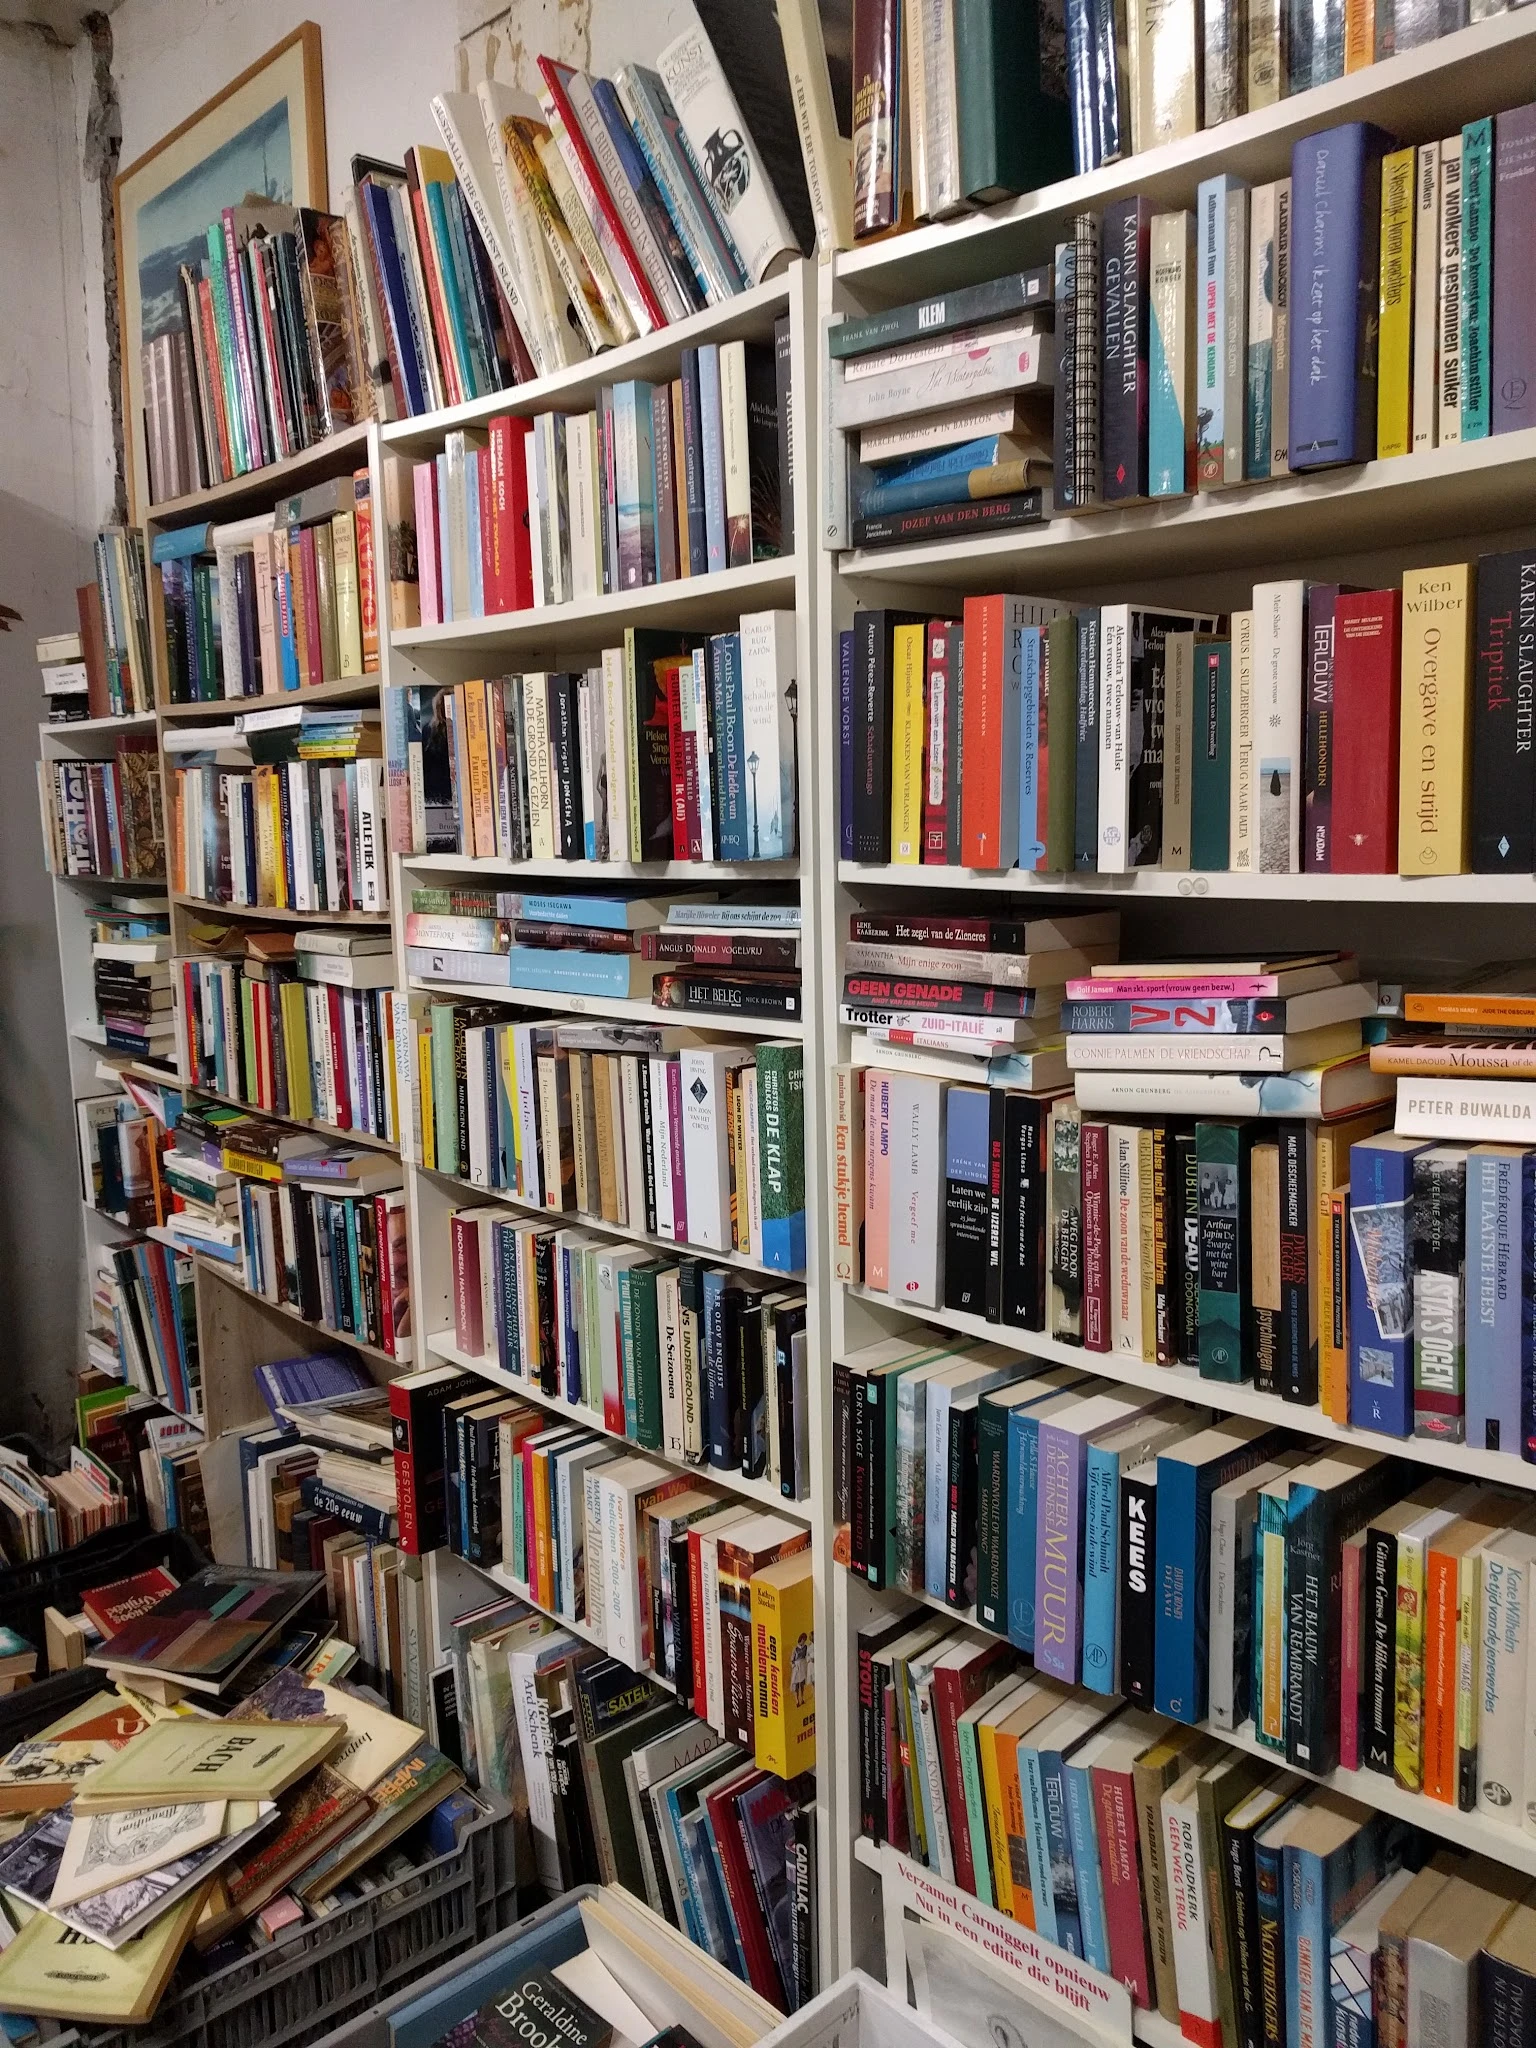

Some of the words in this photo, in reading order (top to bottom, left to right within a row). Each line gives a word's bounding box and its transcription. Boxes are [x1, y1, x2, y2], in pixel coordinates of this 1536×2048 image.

[1442, 157, 1460, 185] jan
[581, 99, 600, 131] HET
[595, 132, 642, 231] BIJBELWOORD
[637, 233, 650, 250] IN
[645, 251, 671, 298] BEELD
[462, 173, 477, 199] THE
[473, 199, 501, 259] GREATEST
[498, 259, 519, 306] ISLAND
[1123, 213, 1139, 271] KARIN
[1445, 188, 1463, 259] wolkers
[918, 302, 946, 329] KLEM
[1104, 257, 1120, 361] GEVALLEN
[1443, 263, 1460, 354] gesponnen
[1122, 277, 1138, 395] SLAUGHTER
[1443, 358, 1461, 408] suiker
[496, 429, 505, 477] HERMAN
[901, 516, 929, 532] JOZEF
[930, 511, 955, 527] VAN
[957, 508, 980, 522] DEN
[982, 503, 1011, 518] BERG
[1406, 598, 1463, 614] Wilber
[1418, 579, 1452, 595] Ken
[1519, 563, 1536, 630] KARIN
[867, 622, 876, 655] Arturo
[1314, 616, 1336, 704] TERLOUW
[1481, 609, 1512, 711] Triptiek
[724, 643, 734, 682] Louis
[842, 641, 850, 703] VALLENDE
[1417, 627, 1442, 737] Overgave
[725, 683, 735, 714] Paul
[867, 656, 876, 722] Pérez-Reverte
[1025, 637, 1036, 741] Strafschopgebieden
[1516, 634, 1535, 754] SLAUGHTER
[726, 715, 737, 753] Boon
[842, 704, 850, 746] VORST
[1317, 709, 1329, 787] HELLEHONDEN
[866, 724, 875, 796] Schaduwtango
[1025, 753, 1034, 796] Reserves
[1421, 744, 1436, 772] en
[1419, 779, 1439, 834] strijd
[362, 811, 375, 870] ATLETIEK
[659, 943, 684, 954] ANGUS
[685, 943, 717, 954] DONALD
[720, 944, 763, 956] VOGELVRIJ
[895, 924, 911, 938] Het
[911, 928, 930, 941] zegel
[930, 930, 943, 939] van
[944, 928, 954, 939] de
[955, 928, 987, 943] Zieneres
[689, 986, 709, 1001] HET
[712, 987, 742, 1003] BELEG
[745, 995, 763, 1004] NICK
[764, 997, 784, 1006] BROWN
[848, 979, 891, 996] GEEN
[893, 981, 963, 1001] GENADE
[1072, 1005, 1115, 1017] ROBERT
[845, 1007, 894, 1025] Trotter
[921, 1016, 985, 1035] ZUID-ITALIË
[1071, 1017, 1115, 1029] HARRIS
[1073, 1048, 1113, 1059] CONNIE
[1115, 1048, 1156, 1059] PALMEN
[1160, 1048, 1174, 1059] DE
[1177, 1048, 1251, 1061] VRIENDSCHAP
[1416, 1058, 1446, 1066] DAOUD
[1448, 1053, 1509, 1068] Moussa
[1523, 1059, 1533, 1067] de
[764, 1069, 773, 1112] TSIOLKAS
[770, 1070, 779, 1113] CHRISTOS
[880, 1081, 889, 1122] HUBERT
[1408, 1099, 1454, 1115] PETER
[1459, 1102, 1532, 1119] BUWALDA
[767, 1113, 780, 1141] DE
[836, 1123, 849, 1150] Een
[879, 1122, 889, 1156] LAMPO
[1287, 1135, 1297, 1160] MARC
[767, 1142, 782, 1194] KLAP
[835, 1152, 852, 1201] stukje
[951, 1184, 972, 1197] Laten
[973, 1188, 986, 1198] we
[1481, 1160, 1496, 1196] HET
[947, 1199, 972, 1212] eerlijk
[973, 1203, 988, 1215] zijn
[1287, 1161, 1298, 1227] DESCHEEMAECKER
[1432, 1171, 1441, 1218] EVELINE
[1498, 1161, 1511, 1241] FRÉDÉRIQUE
[837, 1202, 851, 1247] hemel
[1431, 1220, 1441, 1253] STOEL
[1481, 1197, 1496, 1271] LAATSTE
[457, 1224, 465, 1279] INDONESIA
[1280, 1232, 1294, 1282] LIGGER
[1293, 1233, 1306, 1285] DWARS
[1497, 1242, 1510, 1301] HÉBRARD
[458, 1281, 467, 1331] HANDBOOK
[1420, 1268, 1456, 1335] ASTA'S
[1480, 1275, 1496, 1327] FEEST
[1420, 1336, 1455, 1390] OGEN
[855, 1383, 864, 1426] LORNA
[1046, 1444, 1057, 1460] DE
[401, 1460, 413, 1530] GESTOLEN
[856, 1465, 865, 1504] KWAAD
[1045, 1460, 1057, 1531] CHINESE
[1056, 1447, 1070, 1528] ACHTER
[313, 1494, 324, 1508] de
[325, 1497, 340, 1515] 20e
[341, 1507, 363, 1524] eeuw
[1128, 1495, 1147, 1594] KEES
[1042, 1527, 1068, 1646] MUUR
[1305, 1573, 1319, 1608] HET
[1506, 1567, 1522, 1599] Kate
[1289, 1592, 1304, 1626] VAN
[1505, 1600, 1522, 1654] Wilhelm
[769, 1635, 777, 1662] een
[1304, 1609, 1319, 1666] BLAUW
[523, 1676, 537, 1704] Ard
[757, 1623, 769, 1719] meidenroman
[769, 1663, 780, 1716] keuken
[859, 1648, 872, 1708] STOUT
[1289, 1627, 1303, 1727] REMBRANDT
[190, 1736, 258, 1774] BACH
[527, 1708, 544, 1759] Schenk
[1113, 1785, 1128, 1838] HUBERT
[1168, 1816, 1181, 1851] GEEN
[1181, 1821, 1191, 1842] ROB
[795, 1843, 808, 1915] CADILLAC
[1119, 1839, 1131, 1881] LAMPO
[1172, 1854, 1183, 1884] WEG
[1183, 1843, 1198, 1921] OUDKERK
[897, 1862, 958, 1910] Verzamel
[961, 1903, 1041, 1960] Carmiggelt
[1044, 1955, 1111, 2003] opnieuw
[1174, 1886, 1188, 1932] TERUG
[915, 1891, 935, 1914] Nu
[937, 1905, 951, 1926] in
[955, 1919, 979, 1943] een
[982, 1937, 1023, 1970] editie
[1027, 1964, 1051, 1987] die
[1055, 1978, 1091, 2013] blijft
[1261, 1915, 1280, 2042] NACHTREIZIGERS
[521, 1980, 588, 2046] Geraldine
